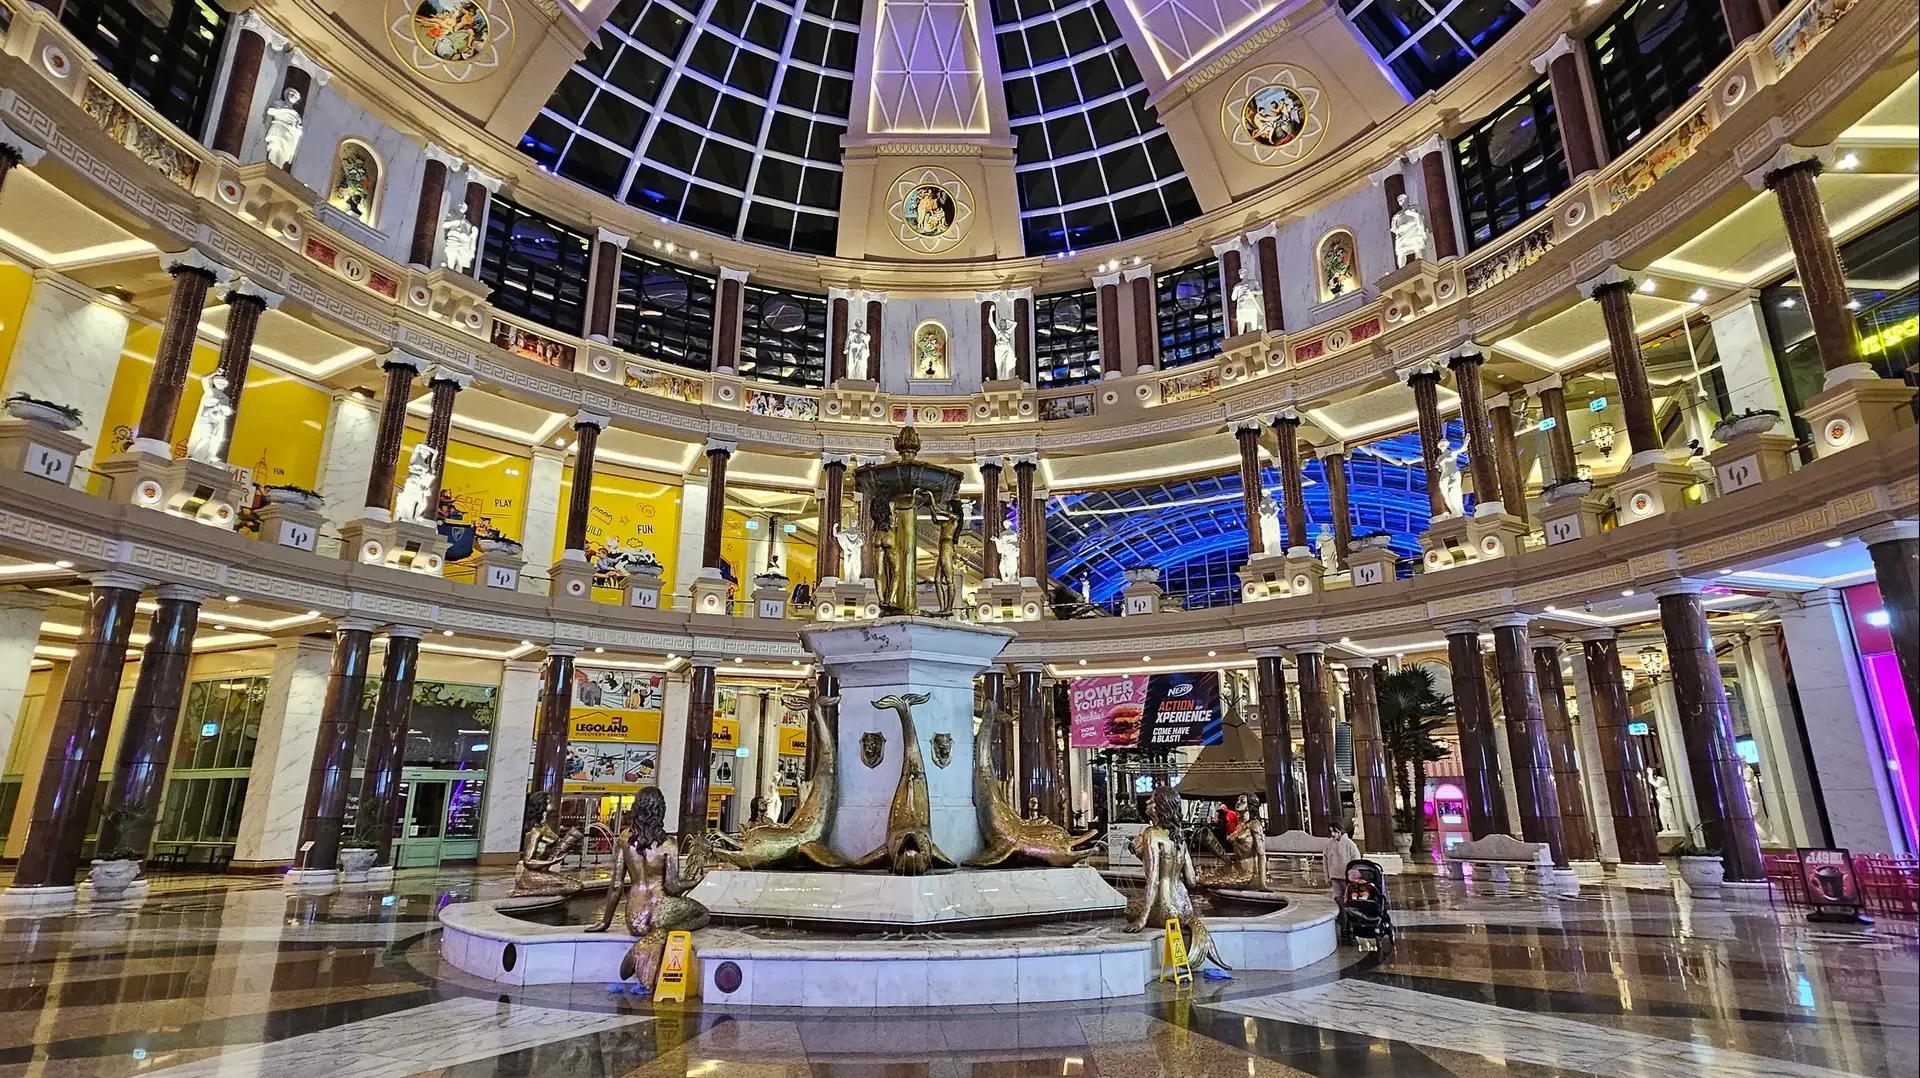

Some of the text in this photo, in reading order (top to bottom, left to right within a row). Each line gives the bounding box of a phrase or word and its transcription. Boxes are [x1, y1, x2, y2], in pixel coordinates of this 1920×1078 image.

[273, 467, 285, 476] FUN
[494, 498, 513, 508] PLAY
[586, 524, 603, 537] UILD
[637, 524, 654, 535] FUN
[1073, 680, 1135, 704] POWER
[1167, 684, 1192, 697] NERF
[1075, 691, 1134, 712] YOUR PLAY
[1157, 700, 1195, 711] ACTION
[1155, 709, 1213, 723] XPERIENCE
[575, 722, 629, 733] LEGOLAND
[1080, 726, 1096, 734] NOW
[1152, 726, 1190, 735] COME HAVE
[1081, 730, 1097, 739] OPEN
[1150, 735, 1156, 743] A
